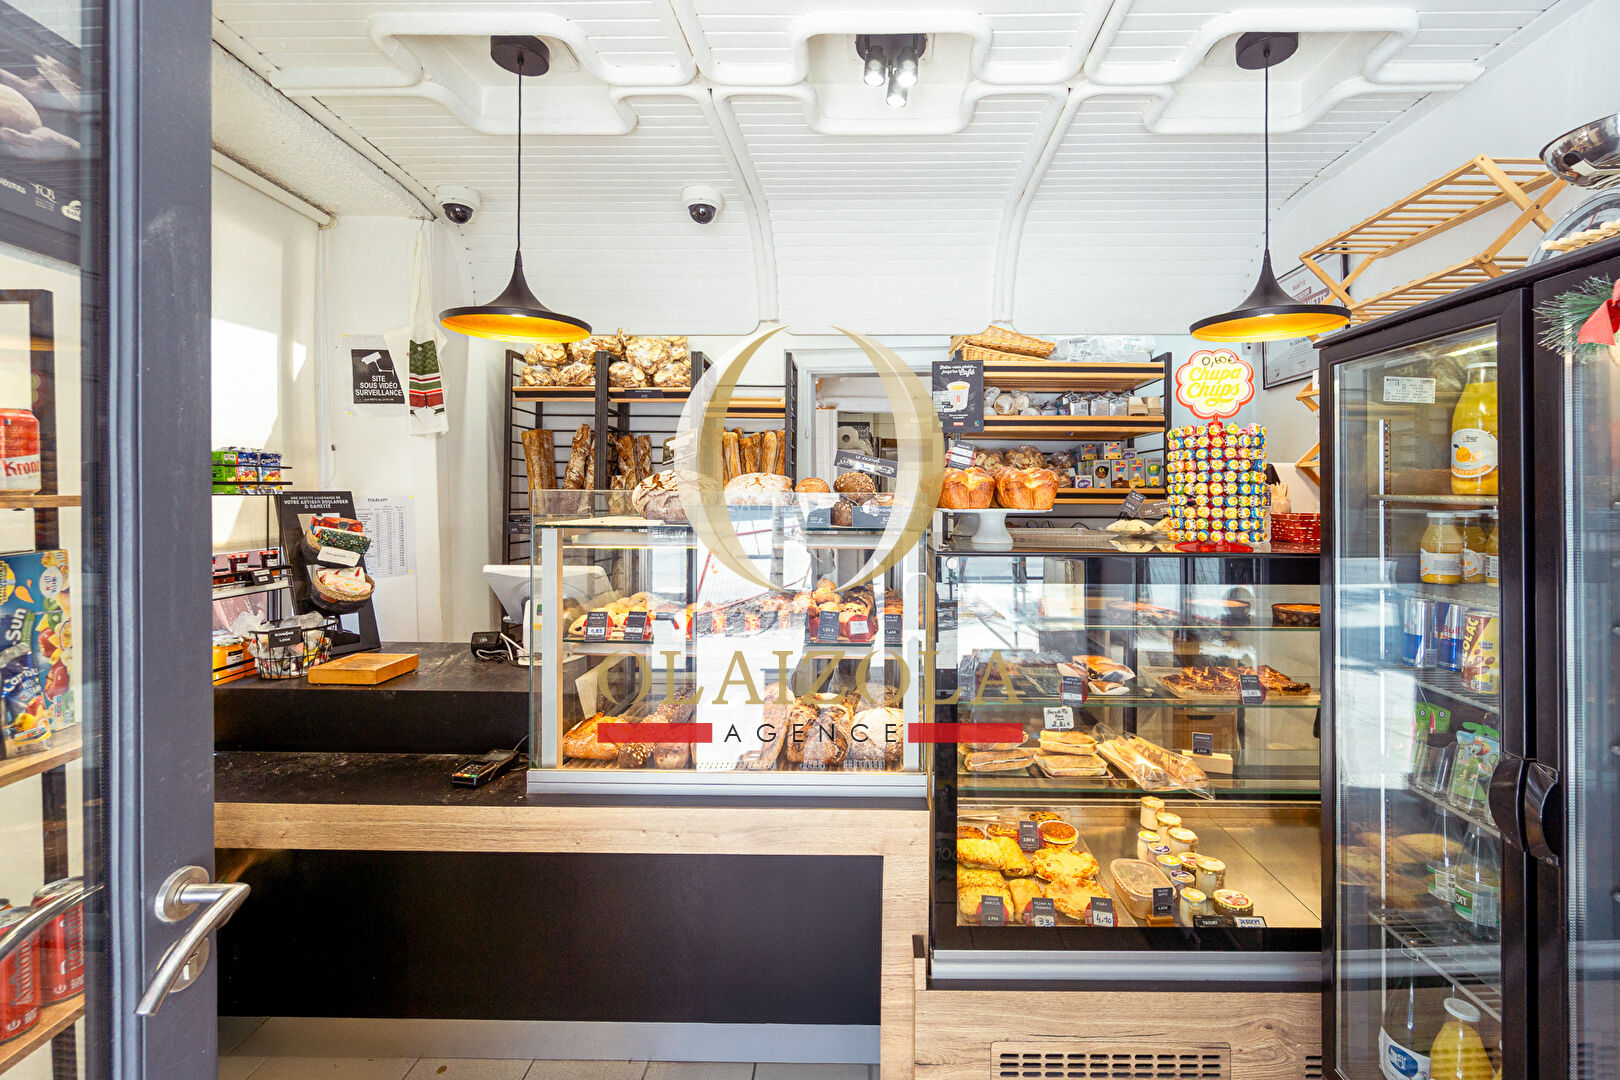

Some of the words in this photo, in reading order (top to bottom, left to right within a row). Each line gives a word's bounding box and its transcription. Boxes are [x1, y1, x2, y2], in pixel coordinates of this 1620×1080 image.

[1189, 367, 1242, 384] Chupa
[379, 381, 398, 389] VIDÉO
[1187, 382, 1240, 402] Chups
[1443, 625, 1460, 634] Bull
